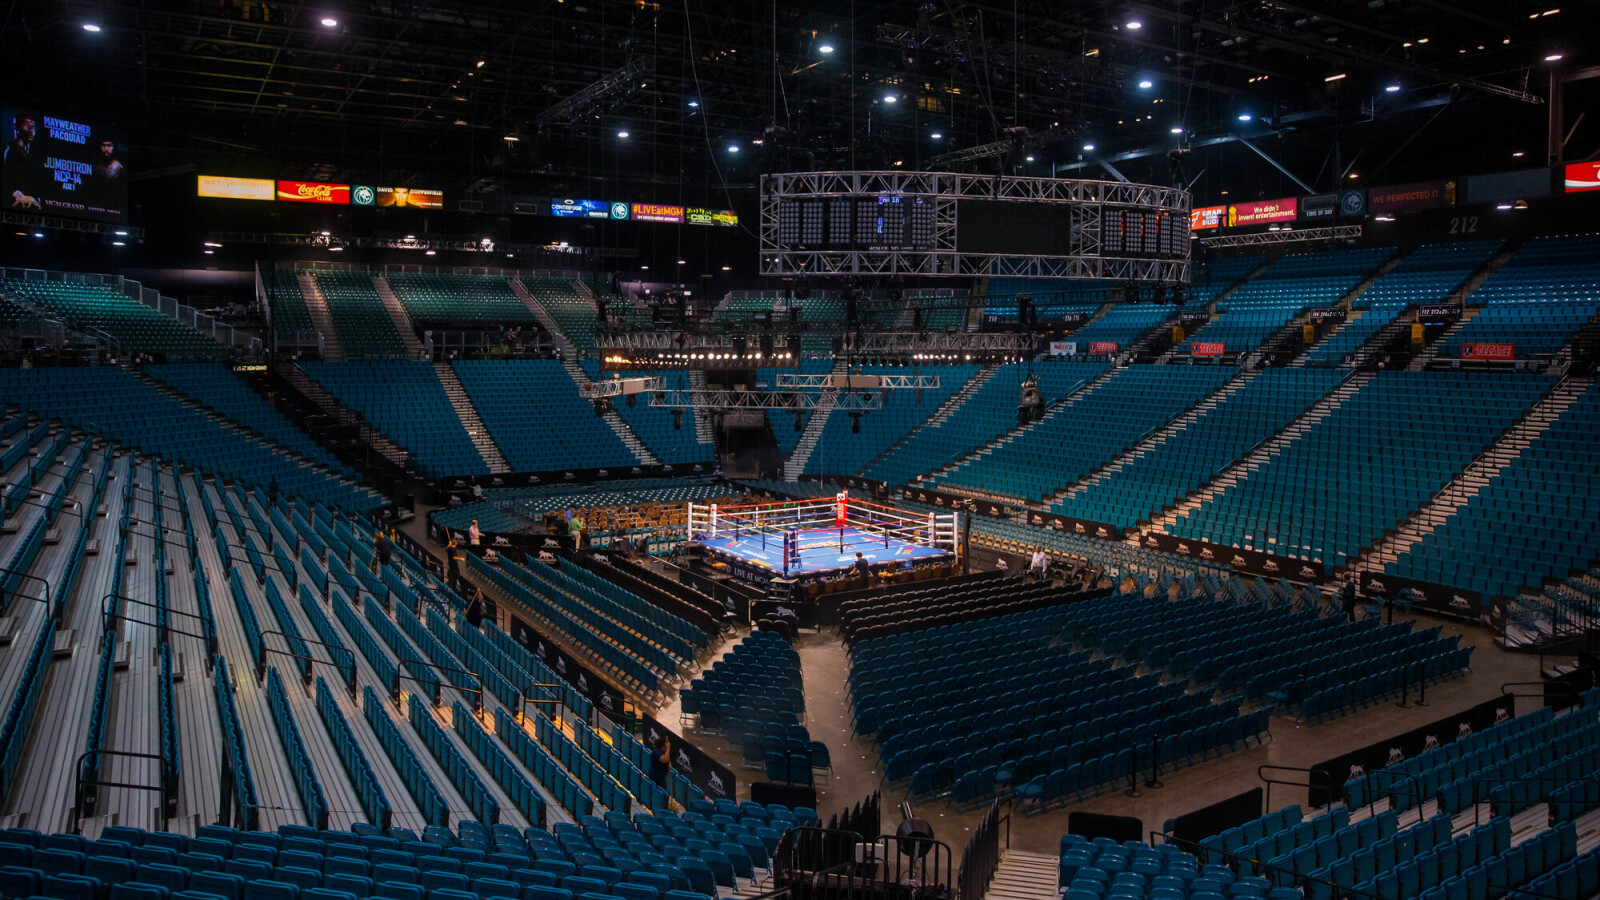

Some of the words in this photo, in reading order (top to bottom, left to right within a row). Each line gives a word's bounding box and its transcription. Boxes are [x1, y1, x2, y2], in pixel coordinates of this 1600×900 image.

[44, 115, 91, 134] MAYWEATHER
[50, 129, 86, 145] PACQUIAO
[44, 156, 92, 176] JUMBOTRON
[54, 169, 82, 185] NCP-14
[295, 184, 332, 197] Coca-Cola
[409, 188, 443, 196] COPPERFIELD
[1373, 196, 1385, 204] WE
[1386, 190, 1432, 203] PERFECTED
[62, 202, 85, 210] GRAND
[632, 204, 684, 217] #LIVEatMGM
[1253, 206, 1263, 214] We
[1263, 204, 1279, 212] didn't
[1238, 213, 1255, 222] invent
[1255, 209, 1296, 220] entertainment.
[1449, 216, 1480, 235] 212
[1475, 344, 1512, 357] TECATE
[734, 567, 746, 579] LIVE
[746, 571, 754, 582] AT
